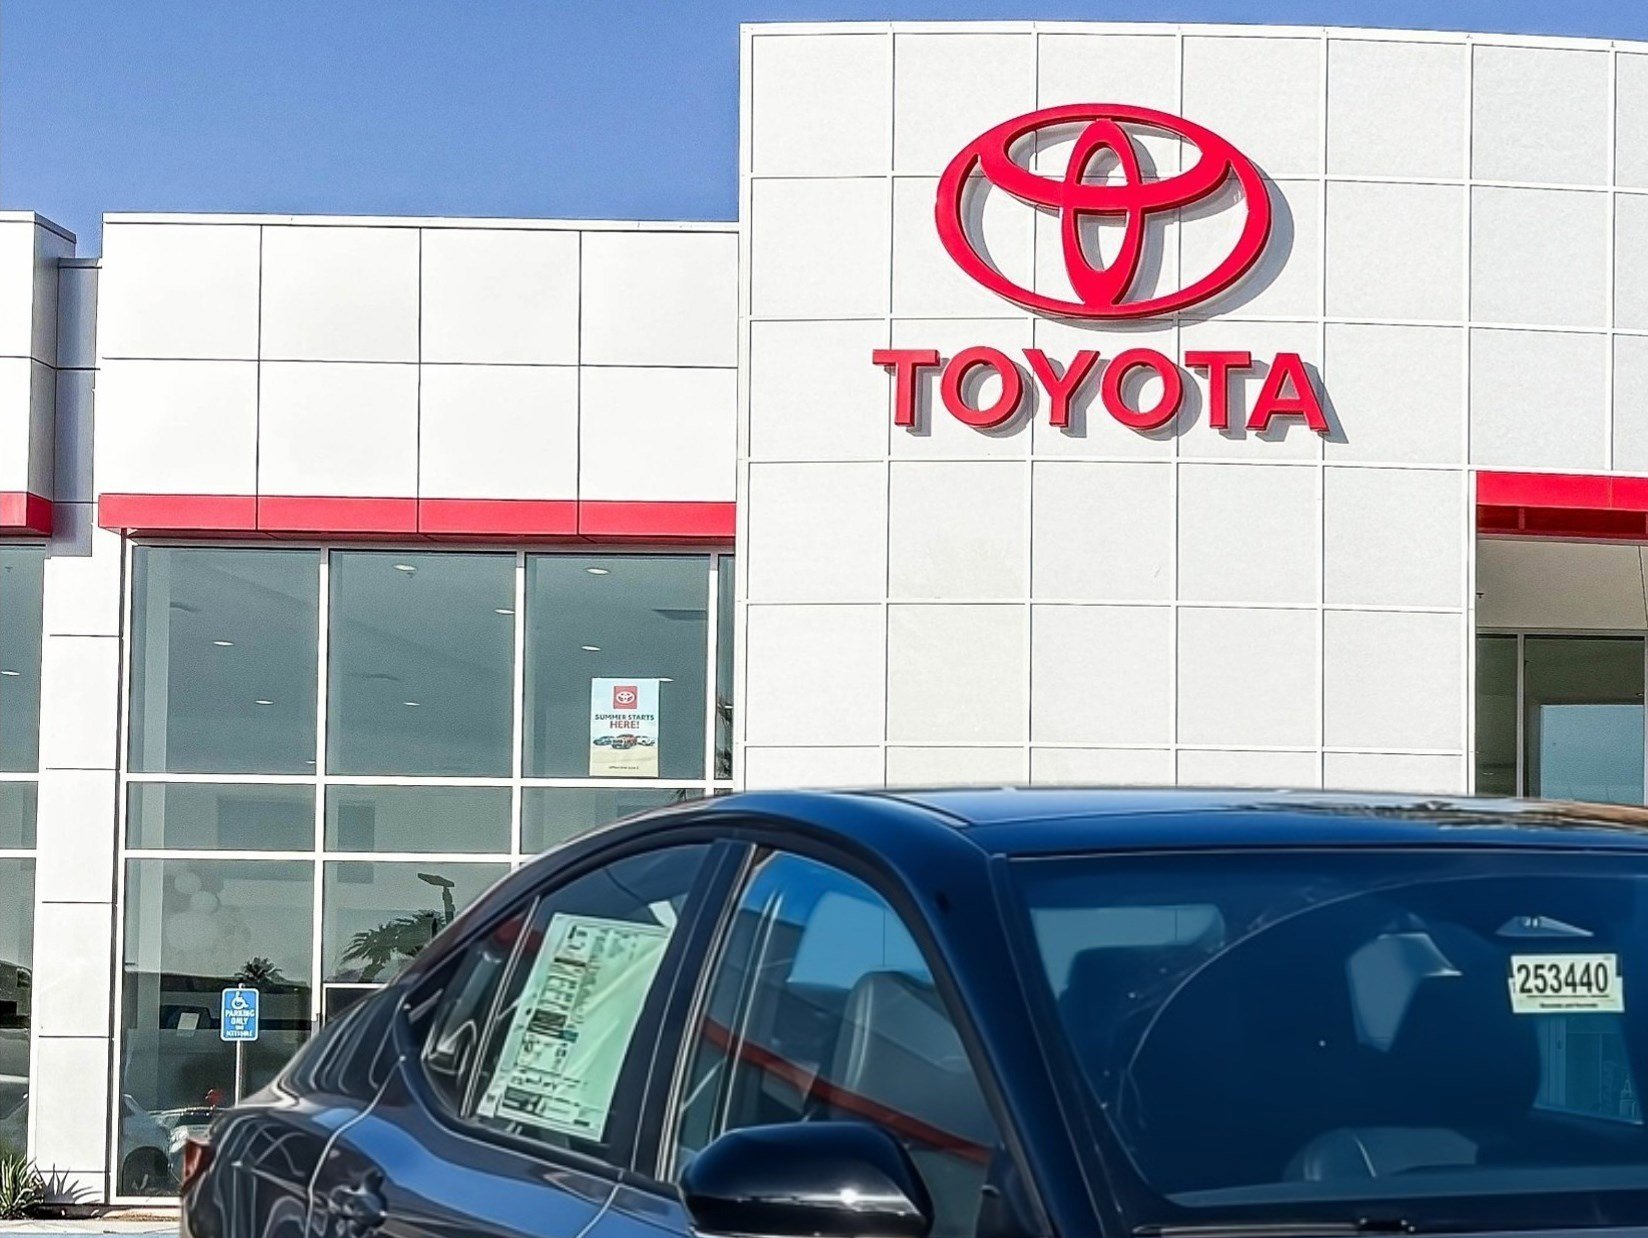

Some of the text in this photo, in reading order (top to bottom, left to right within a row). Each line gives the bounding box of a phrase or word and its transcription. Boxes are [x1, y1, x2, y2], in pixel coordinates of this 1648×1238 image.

[872, 346, 1329, 432] TOYOTA
[610, 720, 640, 729] HERE!
[1517, 962, 1608, 994] 253440
[225, 1009, 255, 1018] PARKING
[230, 1017, 249, 1025] ONLY
